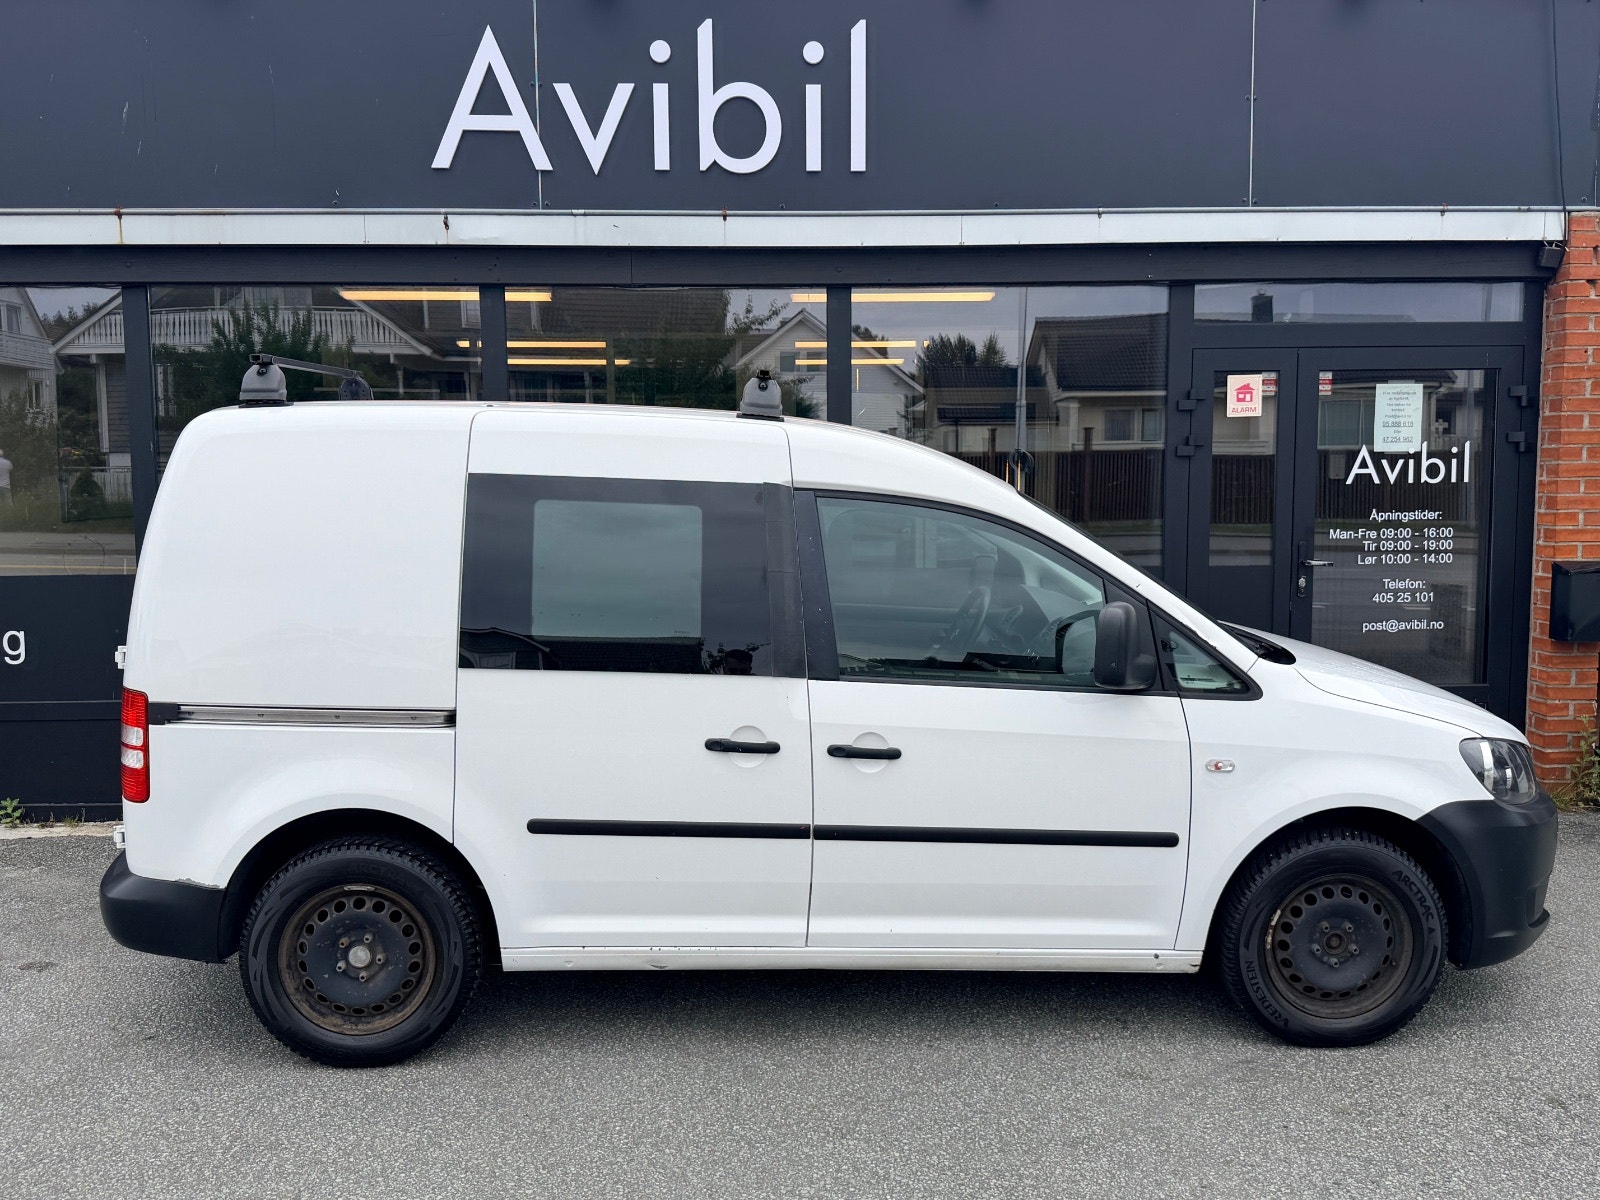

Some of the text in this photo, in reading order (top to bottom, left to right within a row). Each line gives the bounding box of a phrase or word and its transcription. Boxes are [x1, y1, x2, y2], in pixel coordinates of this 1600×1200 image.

[431, 18, 867, 175] Avibil
[1345, 440, 1470, 485] Avibil
[1369, 509, 1442, 523] Åpningstider:
[1329, 528, 1377, 540] Man-Fre
[1380, 527, 1412, 539] 09:00
[1422, 527, 1454, 538] 16:00
[1362, 540, 1378, 551] Tir
[1379, 540, 1412, 551] 09:00
[1422, 539, 1453, 551] 19:00
[1357, 554, 1378, 565] Lør
[1380, 553, 1412, 565] 10:00
[1422, 552, 1453, 564] 14:00
[1382, 578, 1426, 590] Telefon:
[1372, 591, 1434, 603] 405 25 101
[1362, 619, 1444, 633] post@avibil.no
[1391, 869, 1435, 924] ARCTRAC
[1244, 960, 1290, 1028] VREDESTEIN
